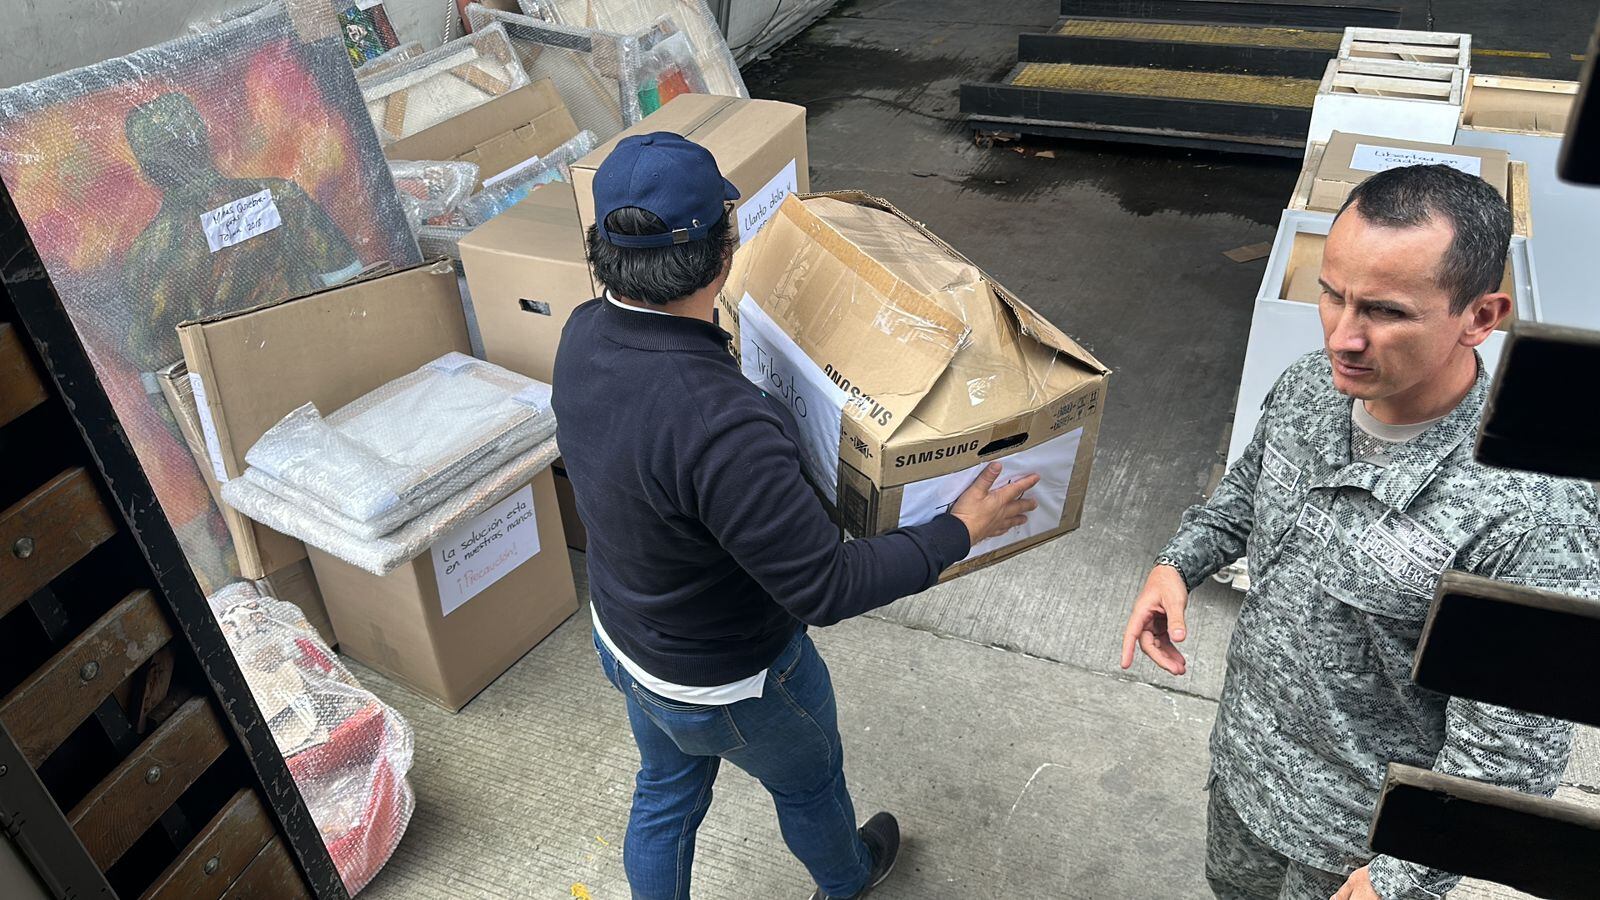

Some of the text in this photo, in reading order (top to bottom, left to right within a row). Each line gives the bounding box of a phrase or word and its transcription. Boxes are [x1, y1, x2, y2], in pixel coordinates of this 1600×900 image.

[1374, 150, 1434, 162] Libertad
[745, 203, 767, 231] Llanto
[751, 339, 807, 418] Tributo
[895, 440, 979, 468] SAMSUNG
[442, 549, 456, 563] La
[460, 518, 504, 551] solución
[445, 509, 533, 575] en nuestras manos
[1363, 532, 1400, 569] FUERZA
